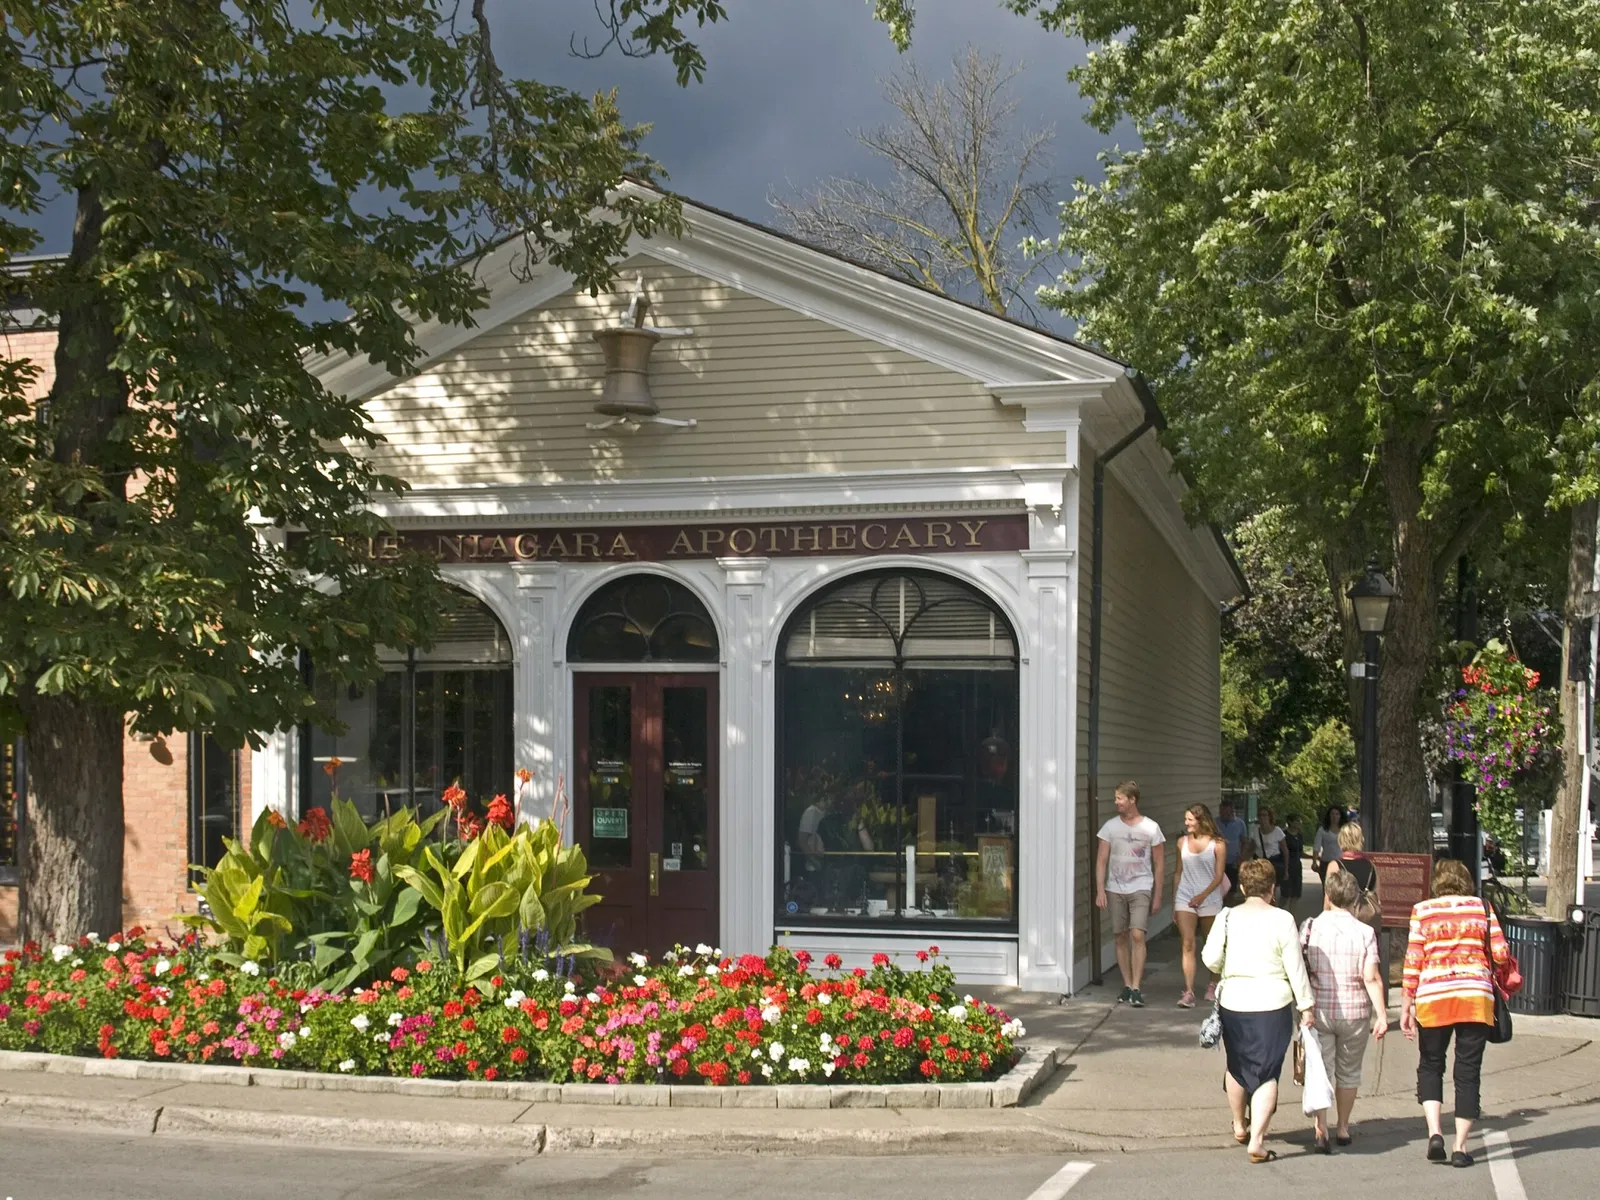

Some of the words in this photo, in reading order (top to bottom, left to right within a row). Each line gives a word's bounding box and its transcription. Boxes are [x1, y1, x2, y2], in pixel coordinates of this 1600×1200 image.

[435, 531, 636, 560] NIAGARA
[666, 520, 988, 555] APOTHECARY
[596, 816, 624, 825] OUVERT
